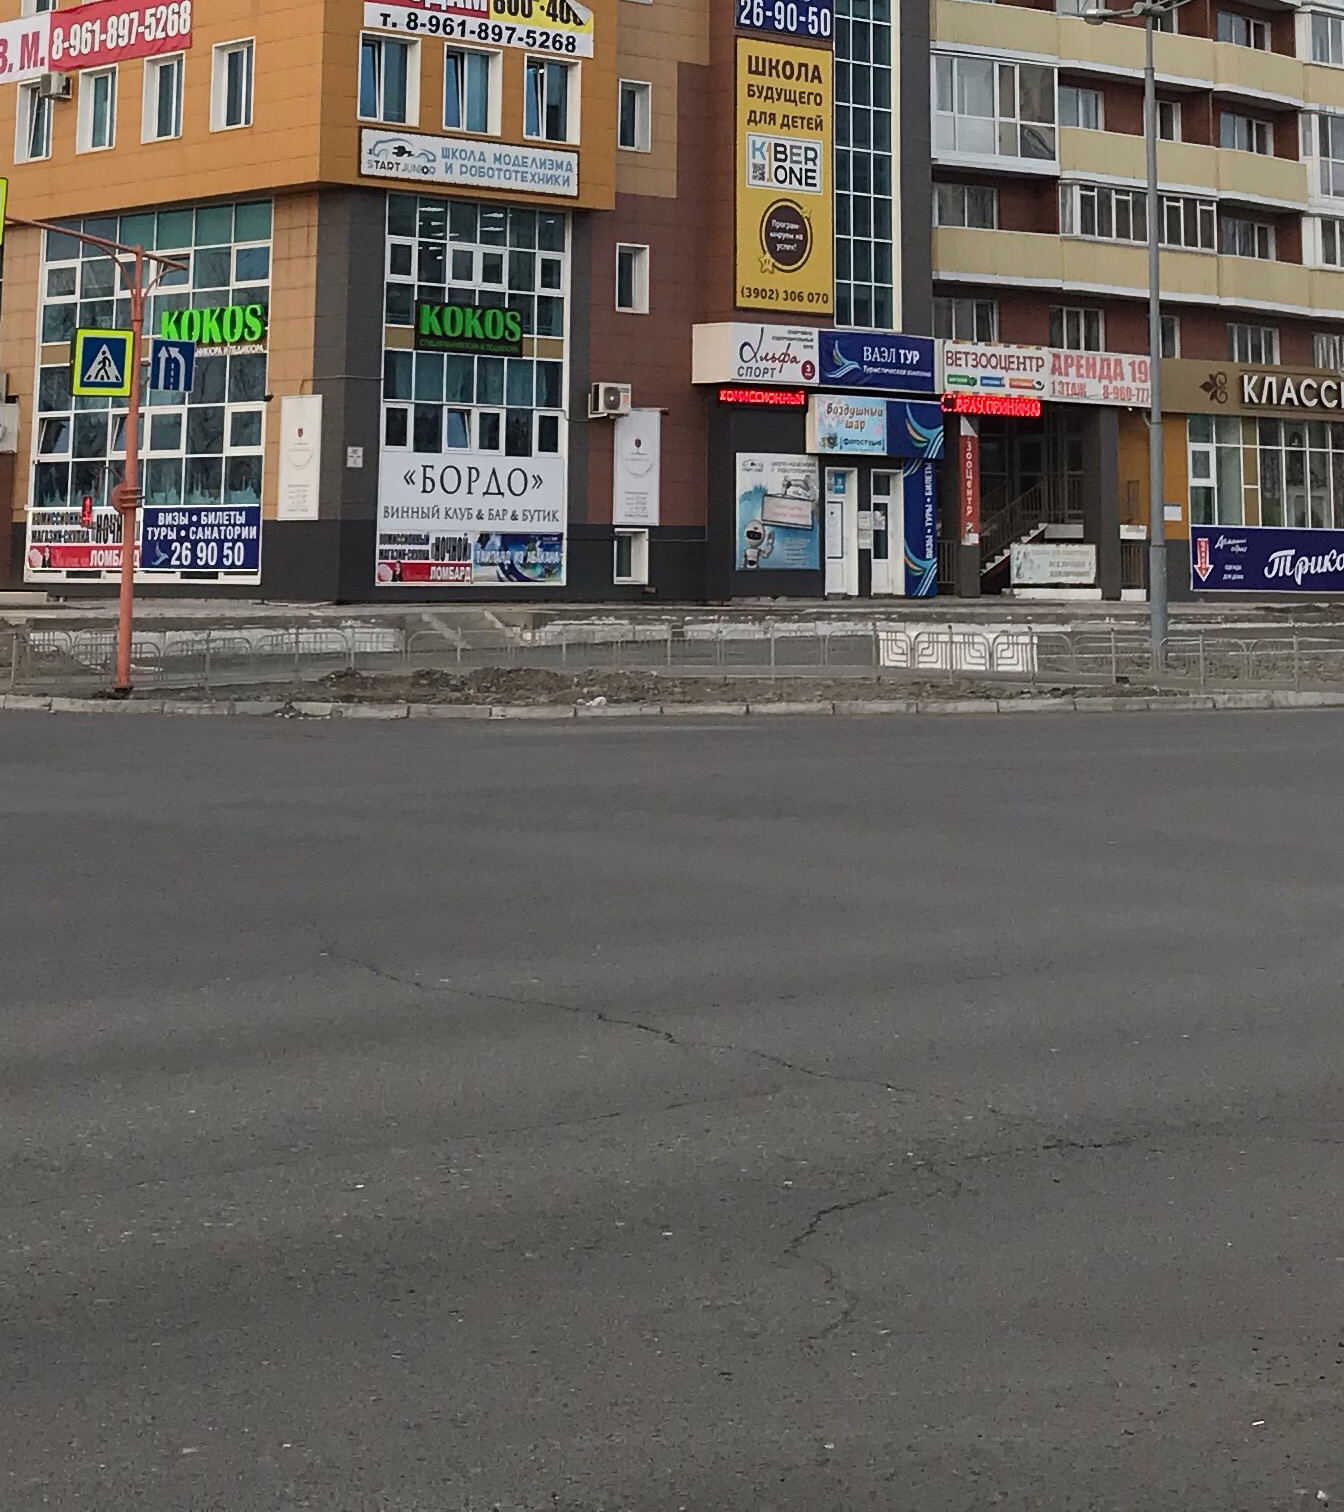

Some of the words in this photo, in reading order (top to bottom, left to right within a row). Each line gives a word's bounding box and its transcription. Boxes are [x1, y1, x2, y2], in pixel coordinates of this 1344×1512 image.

[52, 0, 191, 60] 8-961-897-5268
[406, 12, 576, 53] 8-961-897-5268
[748, 55, 822, 84] ШКОЛА
[747, 83, 823, 107] БУДУЩЕГО
[747, 110, 776, 126] ДЛЯ
[780, 114, 823, 132] ДЕТЕЙ
[441, 147, 487, 163] ШКОЛА
[493, 153, 574, 173] МОДЕЛИЗМА
[445, 163, 453, 174] И
[460, 166, 570, 188] РОБОТОТЕХНИКИ
[774, 165, 817, 187] ONE
[741, 286, 779, 301] (3902)
[783, 290, 804, 302] 306
[807, 292, 829, 304] 070
[161, 304, 264, 343] KOKOS
[419, 304, 522, 342] KOKOS
[863, 346, 896, 363] ВАЭЛ
[898, 349, 920, 365] ТУР
[945, 350, 1045, 372] ВЕТЗООЦЕНТР
[737, 365, 776, 379] СПОРТ
[1050, 353, 1125, 384] АРЕНДА
[719, 389, 805, 405] КОМИССИОННЫЙ
[403, 464, 544, 498] «БОРДО»
[158, 512, 189, 525] ВИЗЫ
[200, 511, 246, 524] БИЛЕТЫ
[383, 505, 440, 519] ВИННЫЙ
[444, 507, 473, 520] КЛУБ
[476, 511, 484, 520] &
[488, 508, 507, 521] БАР
[511, 511, 519, 521] &
[522, 509, 559, 522] БУТИК
[147, 527, 177, 539] ТУРЫ
[189, 526, 257, 539] САНАТОРИИ
[90, 550, 140, 568] ЛОМБД
[170, 542, 191, 566] 26
[197, 542, 218, 566] 90
[222, 541, 244, 566] 50
[430, 566, 470, 581] ЛОМБАРД
